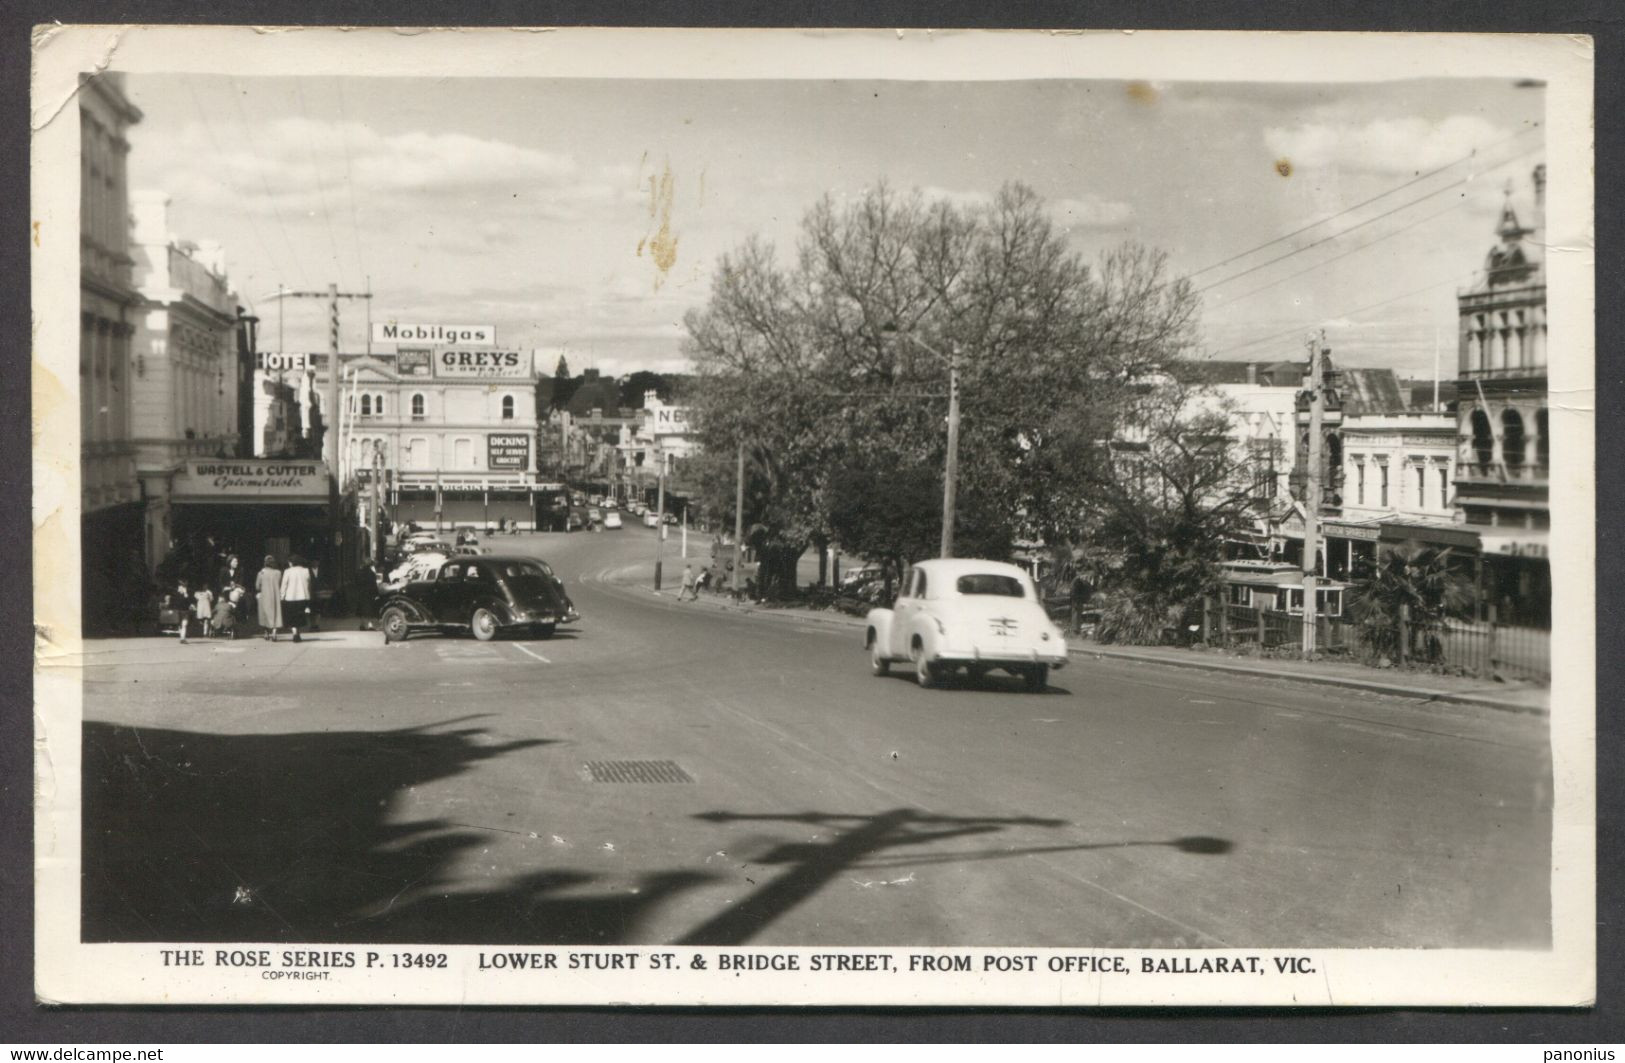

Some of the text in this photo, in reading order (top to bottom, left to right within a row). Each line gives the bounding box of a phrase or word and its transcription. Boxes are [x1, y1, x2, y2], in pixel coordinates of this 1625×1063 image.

[383, 325, 486, 344] Mobilgas
[256, 352, 316, 370] HOTEL
[442, 351, 519, 366] GREYS
[490, 436, 527, 446] DICKINS
[197, 465, 317, 477] WASTELL & CUTTER
